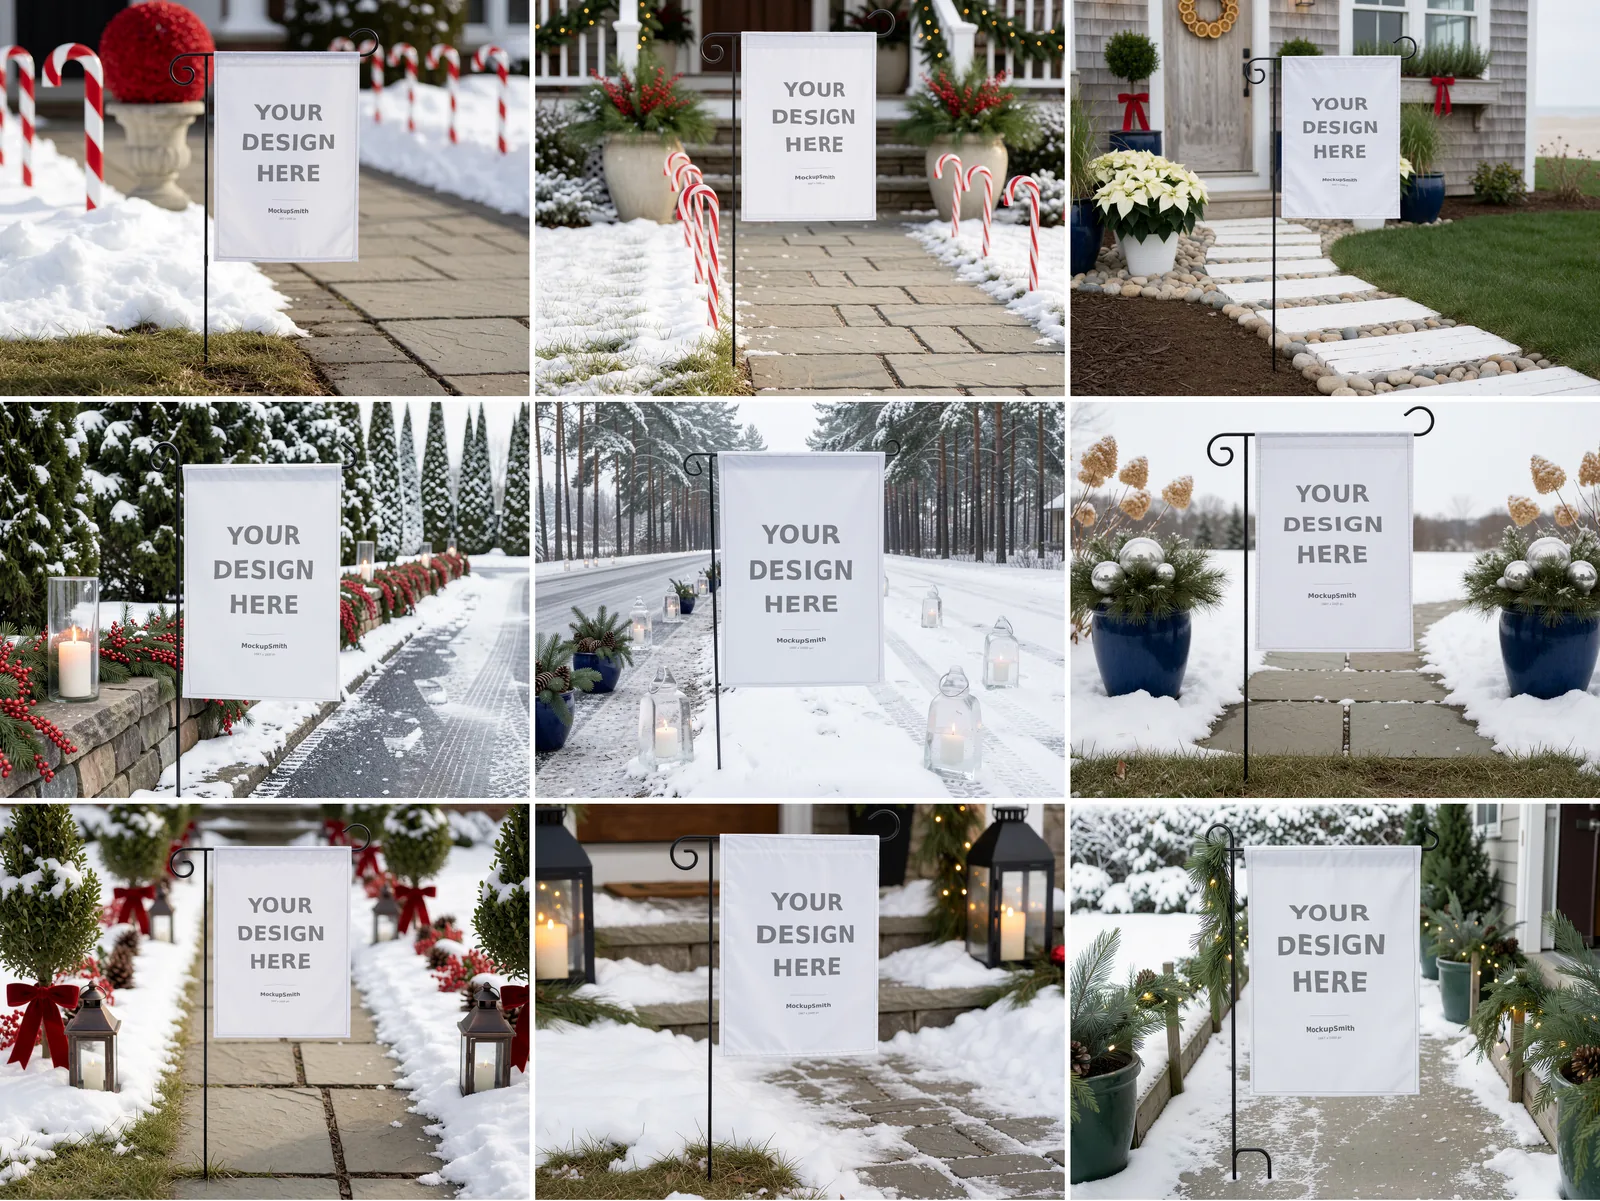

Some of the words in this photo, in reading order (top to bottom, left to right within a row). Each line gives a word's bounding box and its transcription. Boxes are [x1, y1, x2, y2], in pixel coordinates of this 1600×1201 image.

[783, 81, 845, 97] YOUR
[254, 104, 322, 121] YOUR
[1311, 97, 1368, 111] YOUR
[772, 109, 855, 125] DESIGN
[1303, 121, 1378, 135] DESIGN
[242, 133, 334, 151] DESIGN
[786, 136, 843, 153] HERE
[1314, 144, 1366, 159] HERE
[258, 164, 319, 182] HERE
[1296, 484, 1369, 503] YOUR
[1284, 516, 1382, 532] DESIGN
[227, 525, 300, 545] YOUR
[762, 524, 840, 544] YOUR
[1298, 544, 1367, 564] HERE
[214, 559, 313, 580] DESIGN
[750, 560, 852, 581] DESIGN
[230, 594, 298, 614] HERE
[765, 595, 838, 613] HERE
[1308, 592, 1356, 600] MockupSmith
[248, 897, 312, 914] YOUR
[771, 892, 843, 911] YOUR
[1289, 904, 1370, 922] YOUR
[238, 925, 324, 942] DESIGN
[757, 925, 854, 944] DESIGN
[1278, 934, 1385, 956] DESIGN
[251, 953, 310, 969] HERE
[774, 957, 840, 977] HERE
[1293, 970, 1367, 993] HERE
[1306, 1025, 1355, 1033] MockupSmith
